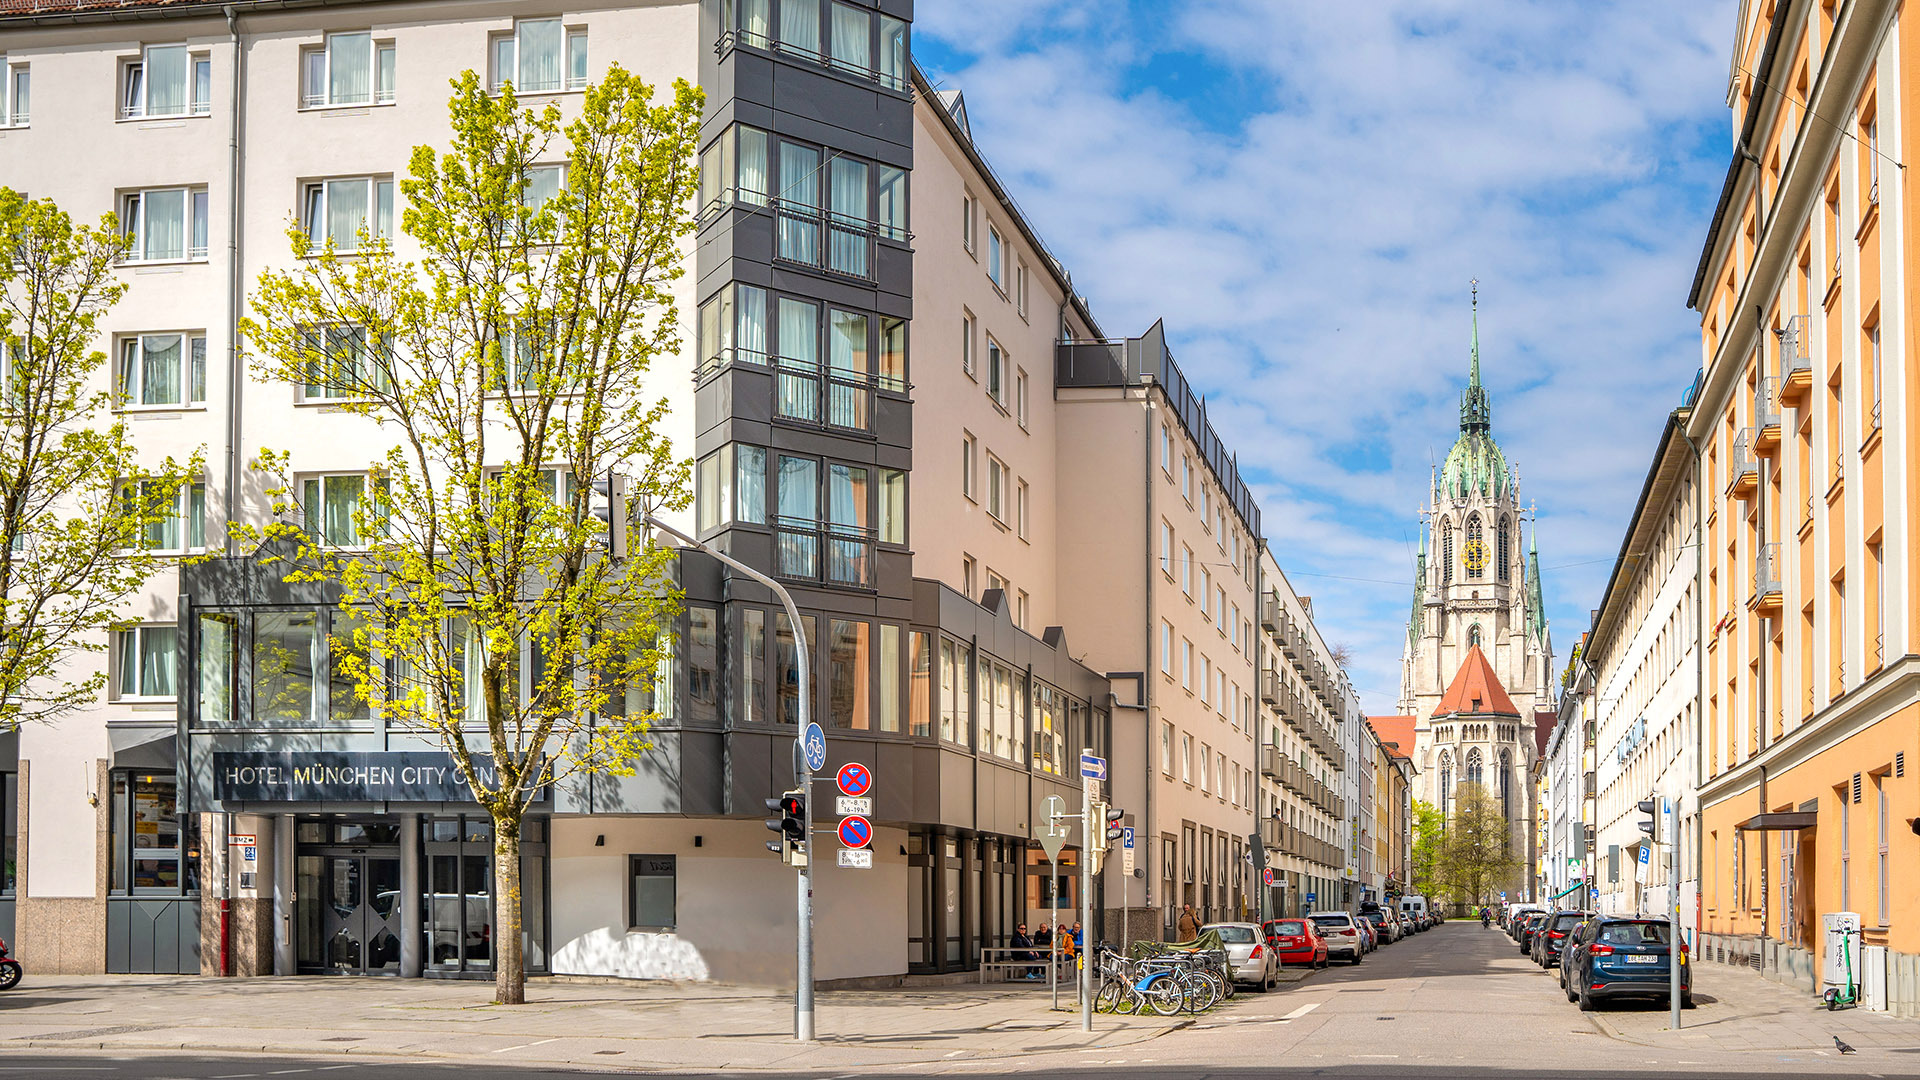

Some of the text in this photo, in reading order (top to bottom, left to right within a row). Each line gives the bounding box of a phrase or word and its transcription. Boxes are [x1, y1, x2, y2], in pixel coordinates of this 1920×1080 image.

[226, 766, 289, 785] HOTEL
[294, 763, 395, 786] MÜNCHEN
[401, 766, 447, 785] CITY
[1125, 829, 1132, 846] P
[1640, 848, 1647, 861] P
